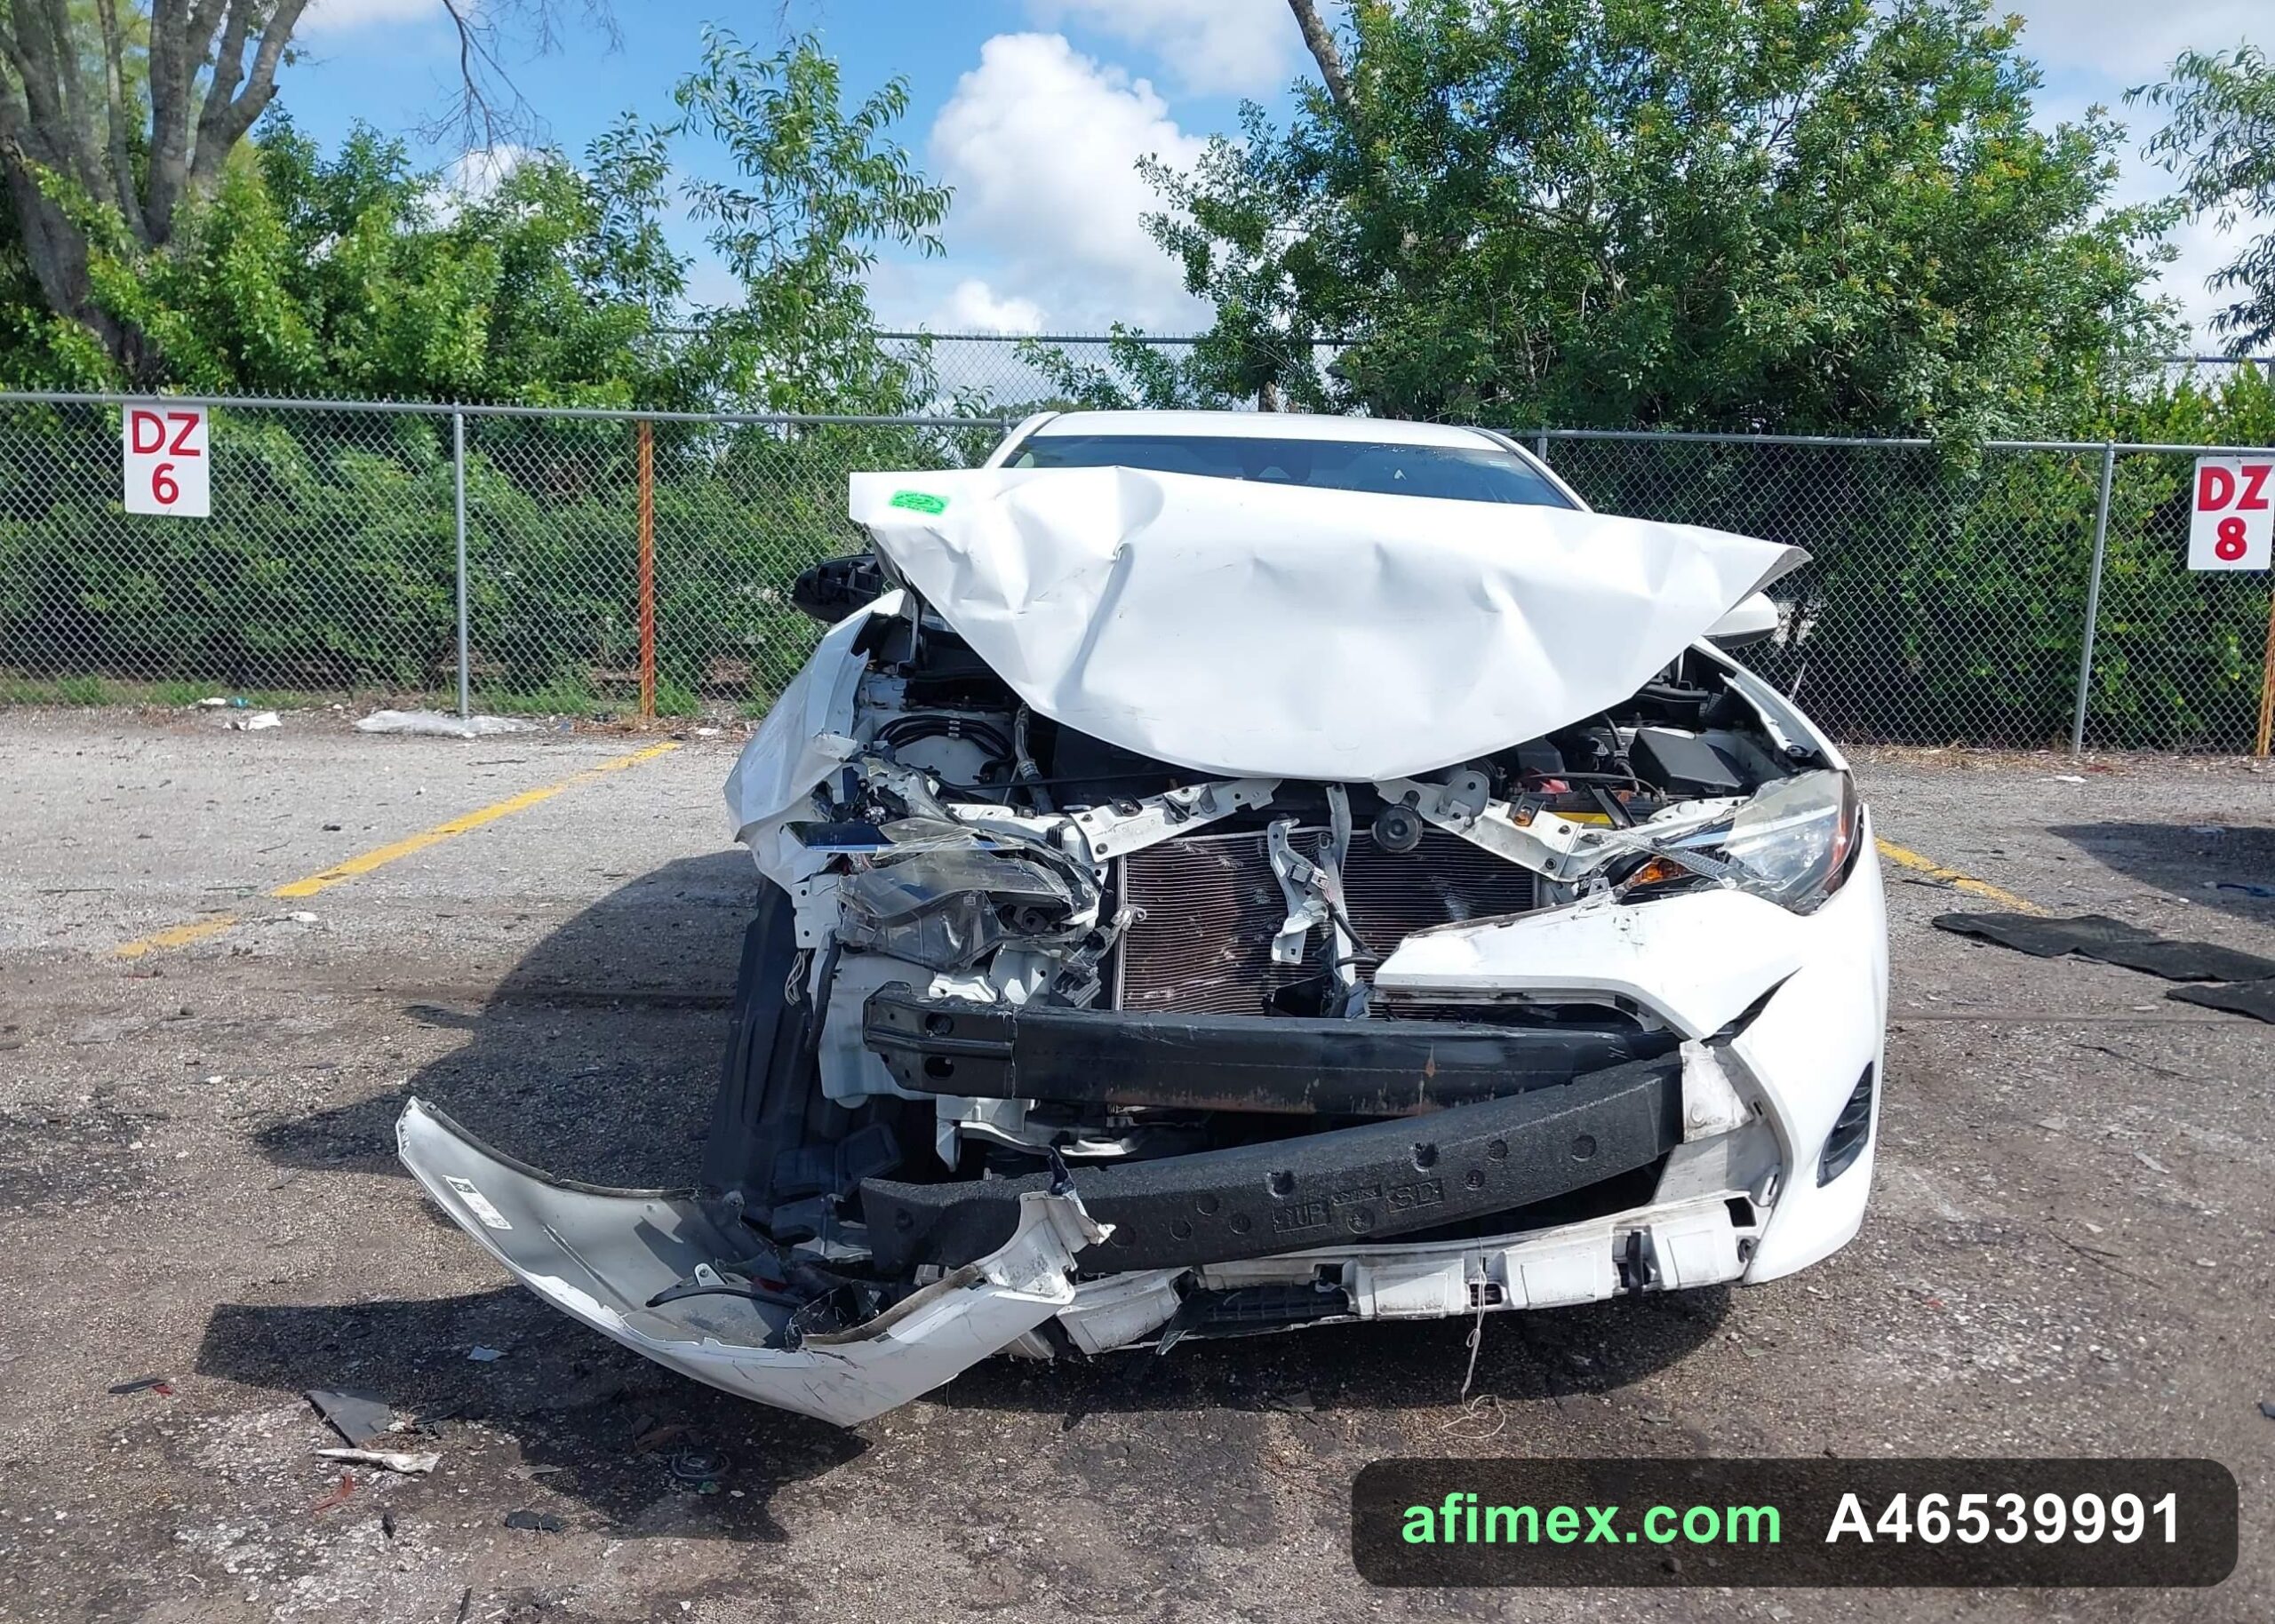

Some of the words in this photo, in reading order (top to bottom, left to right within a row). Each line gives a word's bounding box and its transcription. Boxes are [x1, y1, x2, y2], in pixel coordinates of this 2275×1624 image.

[132, 410, 201, 457] DZ
[152, 463, 179, 504] 6
[2198, 465, 2273, 511] DZ
[2215, 516, 2247, 561] 8
